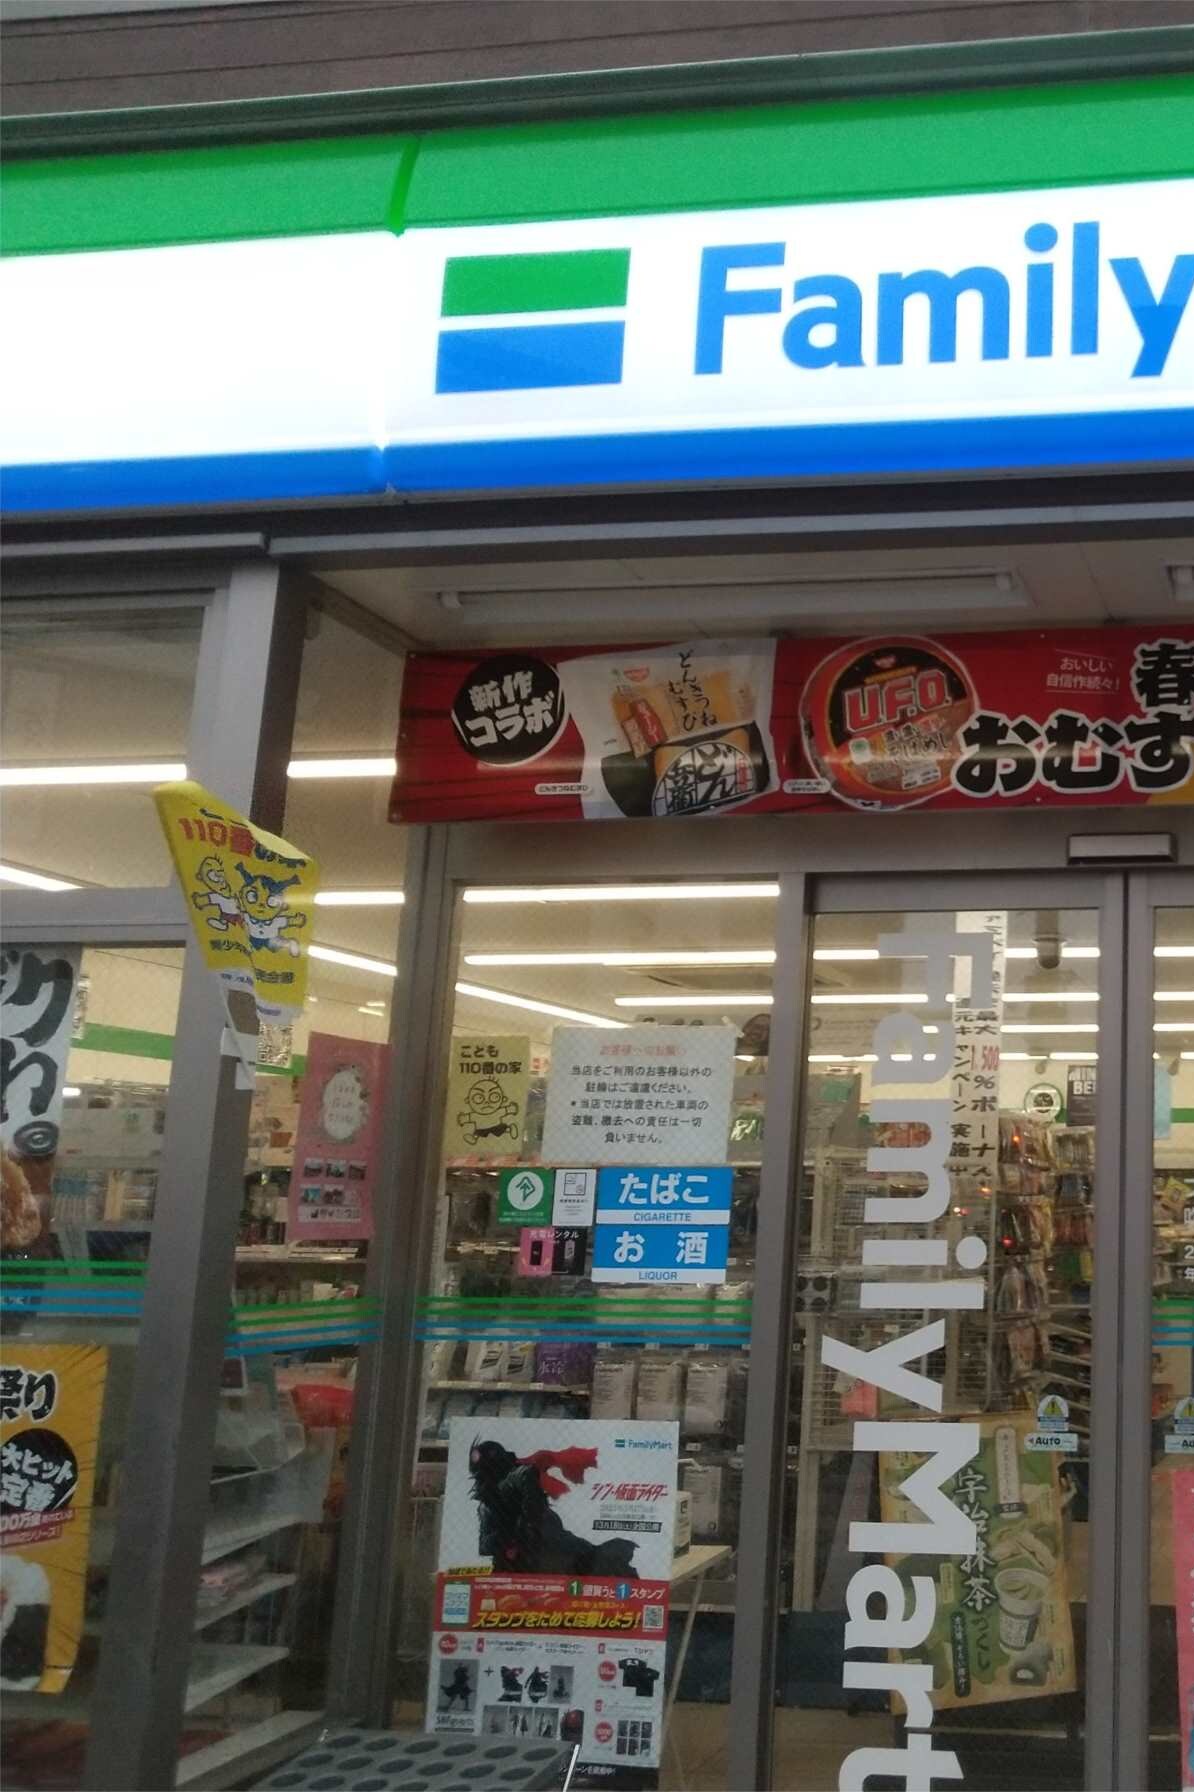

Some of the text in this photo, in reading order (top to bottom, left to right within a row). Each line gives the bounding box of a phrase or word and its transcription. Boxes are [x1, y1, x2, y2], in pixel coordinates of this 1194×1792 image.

[1060, 656, 1113, 672] おいしい
[468, 671, 533, 712] 新作
[1046, 674, 1120, 691] 自信作続々!
[465, 690, 555, 747] コラボ
[459, 1061, 522, 1075] 110番の家
[572, 1066, 712, 1077] 当店をご利用のお客様以外の
[604, 1132, 662, 1143] 負いません。
[618, 1173, 709, 1205] たばこ
[633, 1213, 692, 1222] CIGARETTE
[614, 1230, 709, 1264] お酒
[638, 1272, 678, 1281] LIQUOR
[822, 932, 994, 1792] FamilyMart
[0, 1368, 56, 1421] 祭り
[628, 1439, 673, 1450] FamilyMart
[2, 1442, 74, 1486] 大ヒット
[1, 1472, 56, 1511] 定番
